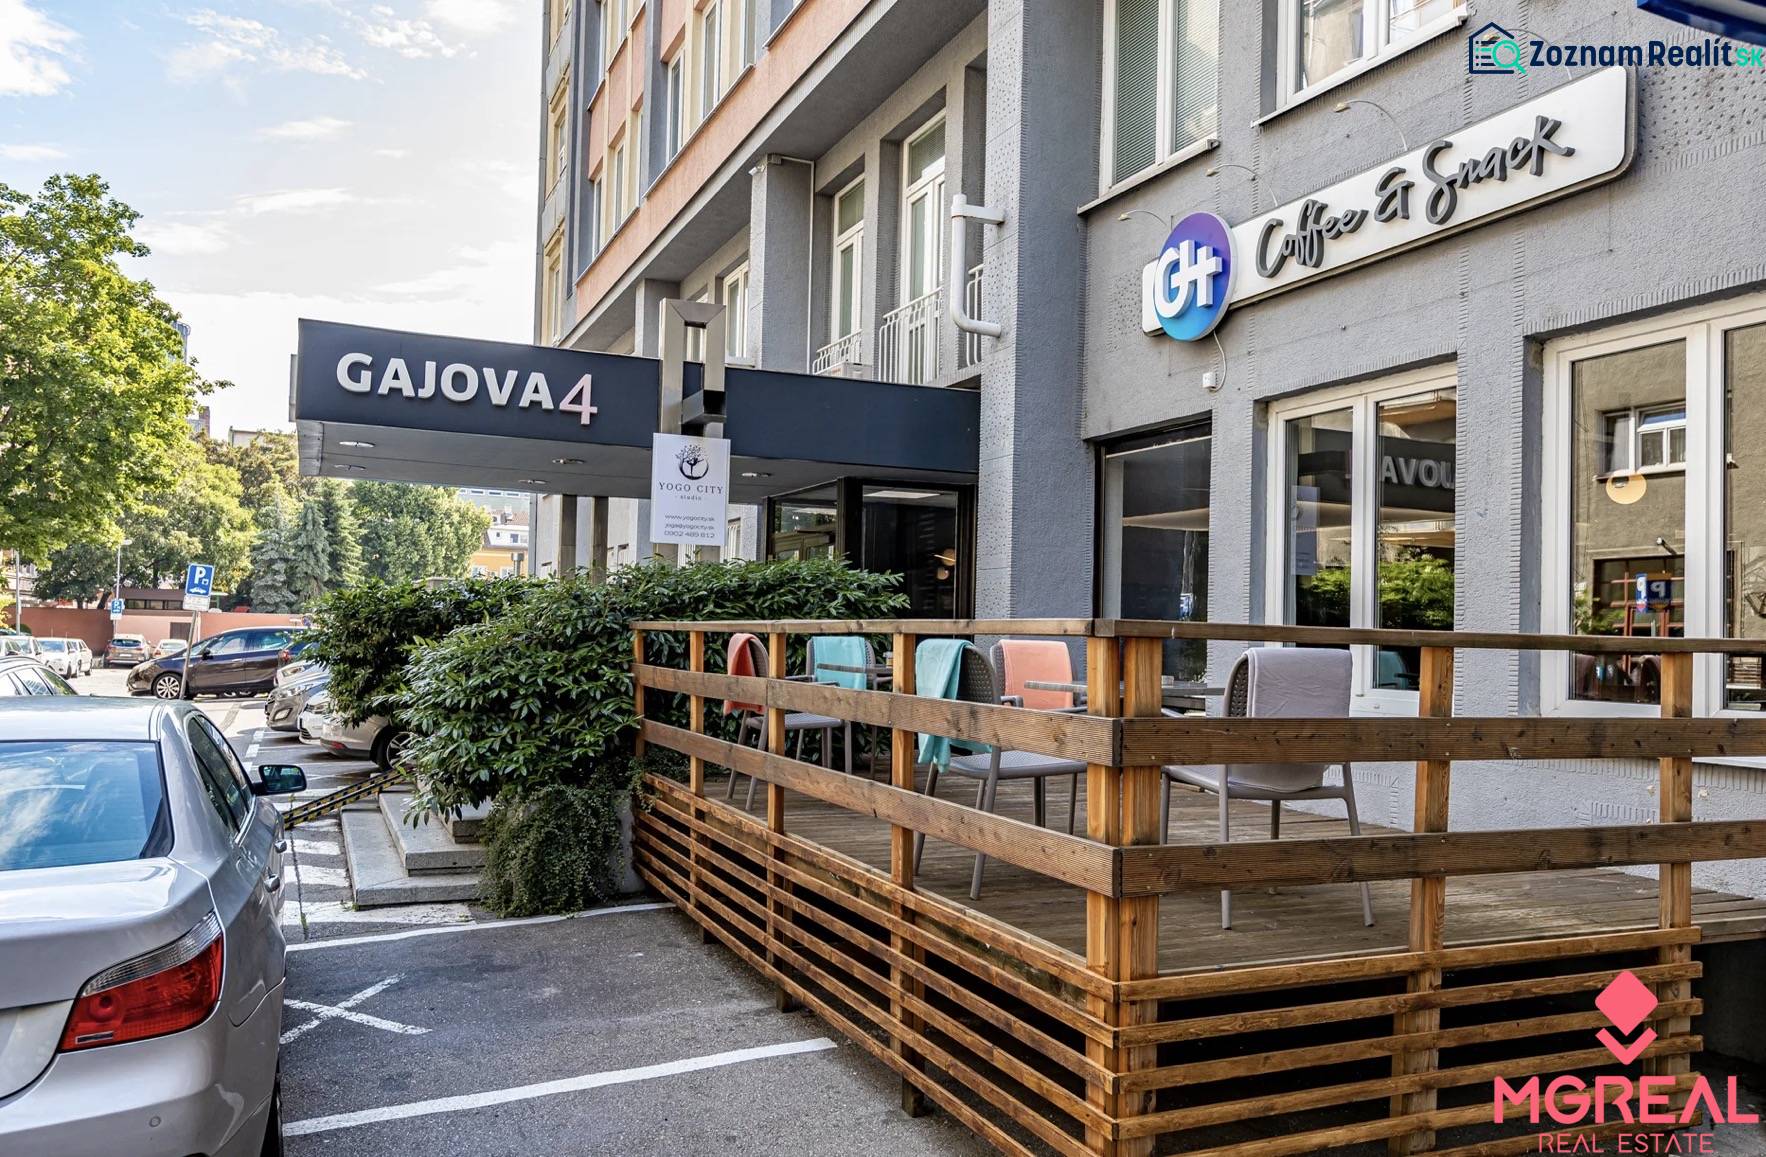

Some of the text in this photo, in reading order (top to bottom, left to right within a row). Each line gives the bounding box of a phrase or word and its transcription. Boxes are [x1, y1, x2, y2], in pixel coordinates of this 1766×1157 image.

[1255, 198, 1369, 278] Coffee
[1374, 166, 1415, 223] &
[658, 481, 723, 494] YOGO CITY
[194, 566, 206, 585] P
